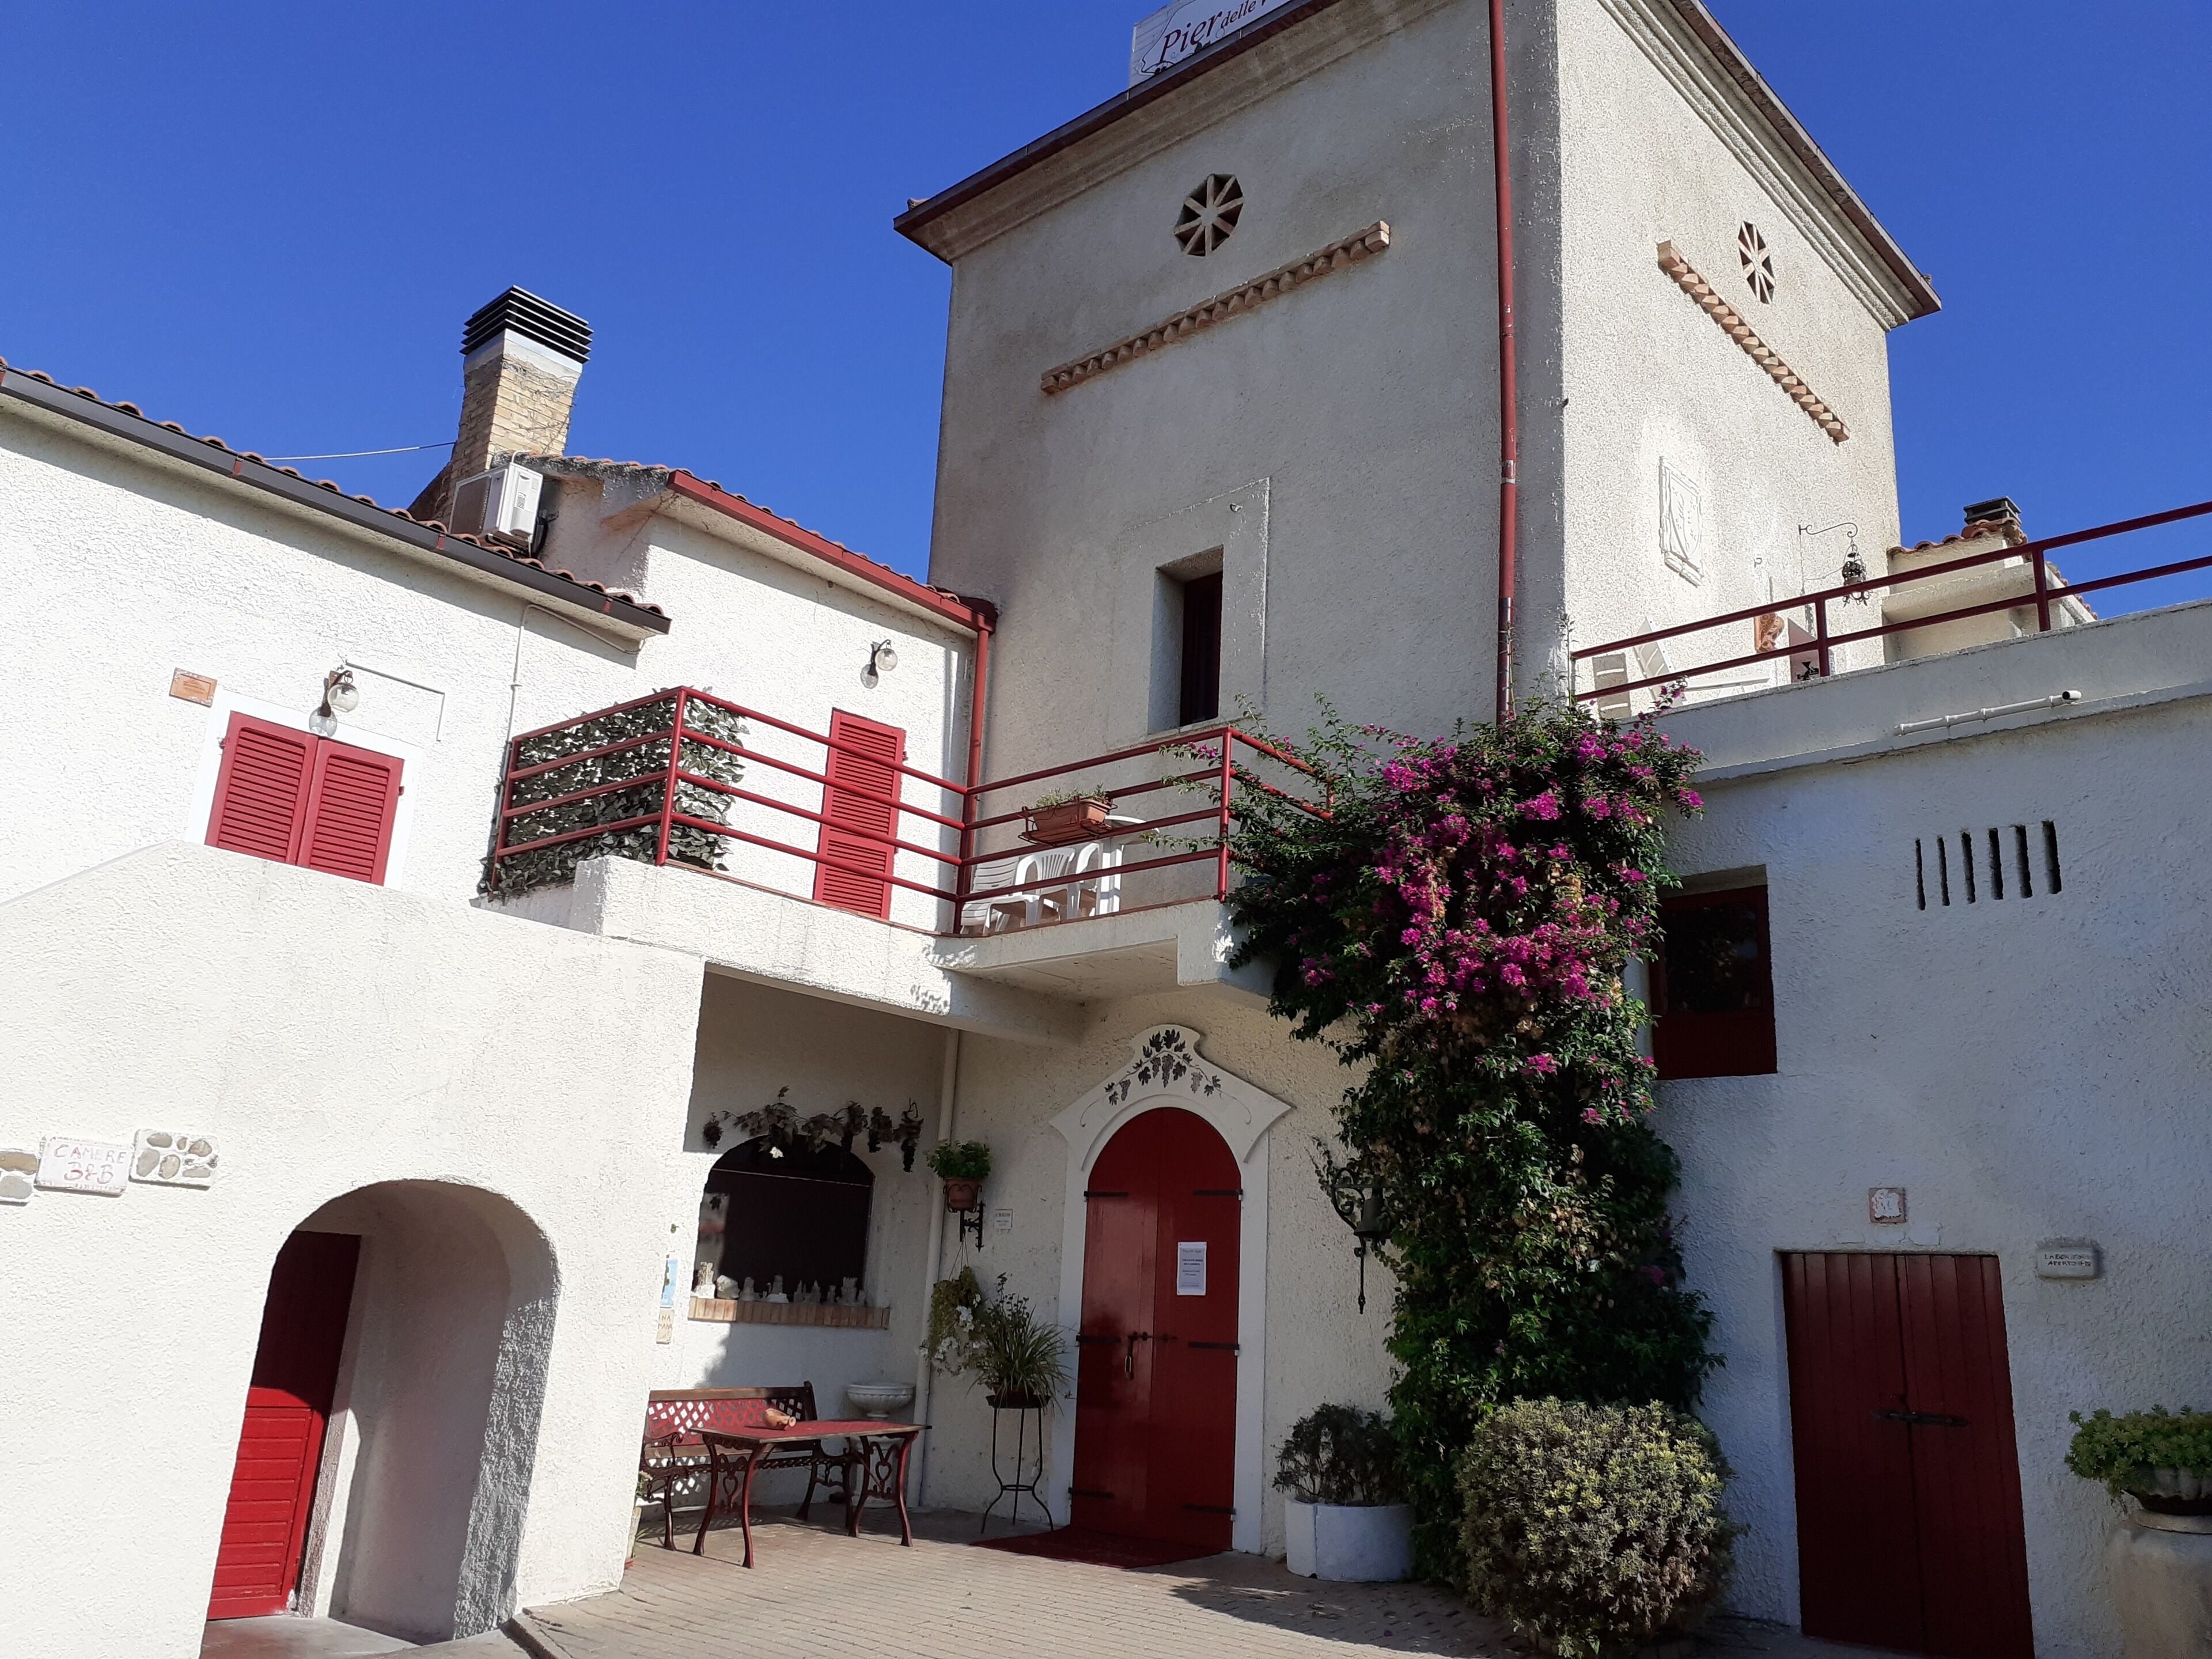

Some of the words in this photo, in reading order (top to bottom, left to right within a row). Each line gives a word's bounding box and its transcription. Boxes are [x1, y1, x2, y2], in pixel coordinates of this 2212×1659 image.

[1159, 11, 1223, 63] Pier
[1220, 0, 1256, 29] delle
[54, 1144, 127, 1164] CAMERE
[63, 1161, 114, 1184] B&B
